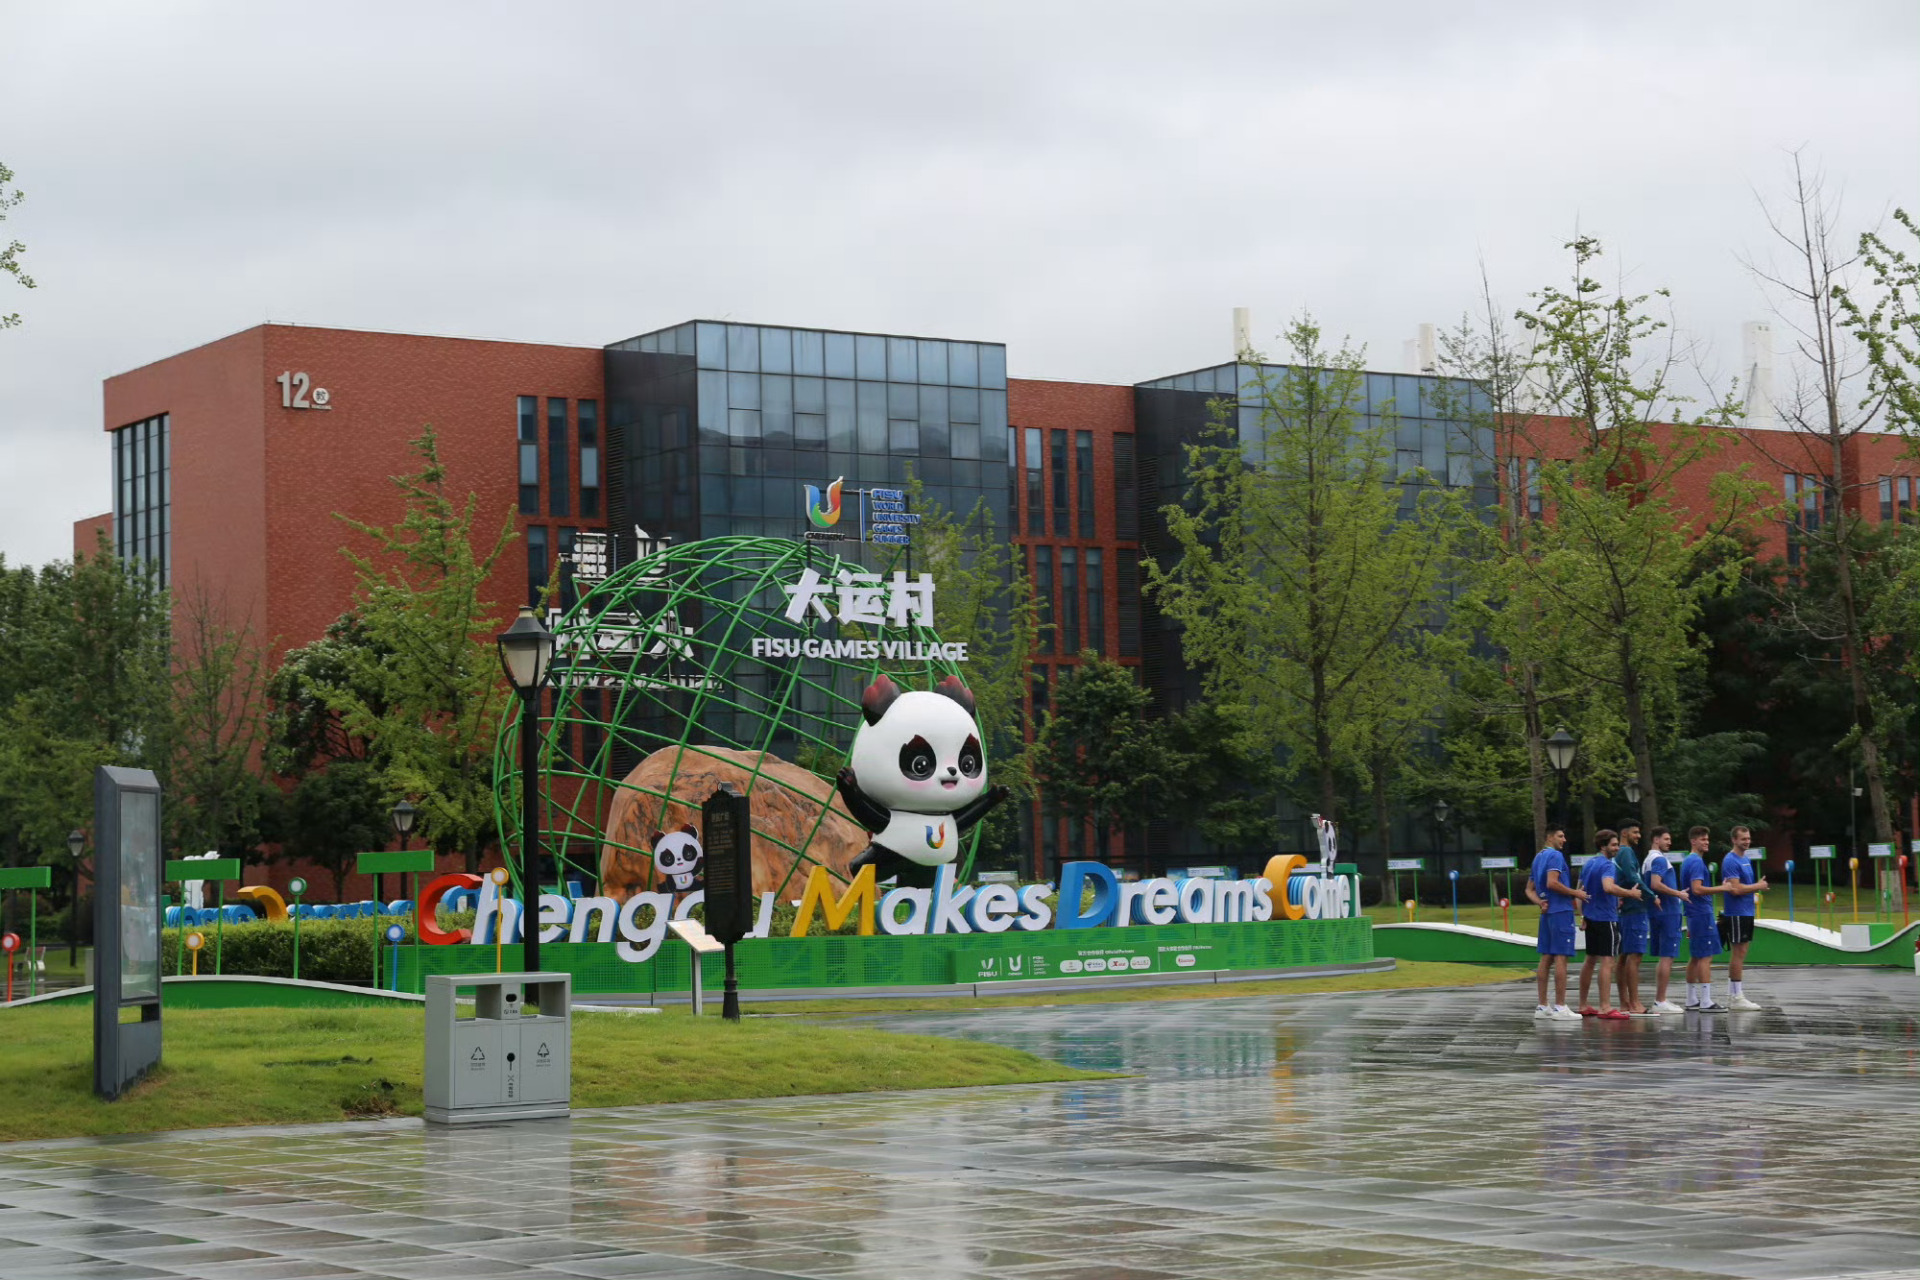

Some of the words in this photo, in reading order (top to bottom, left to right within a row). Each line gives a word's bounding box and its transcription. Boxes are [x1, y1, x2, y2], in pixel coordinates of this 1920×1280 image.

[277, 371, 310, 408] 12
[871, 489, 903, 500] FISU
[872, 500, 905, 512] WORLD
[872, 512, 921, 524] UNIVERSITY
[873, 523, 903, 534] GAMES
[873, 534, 910, 545] SUMMER
[784, 567, 936, 628] 大运村
[752, 637, 800, 658] FISU
[802, 638, 880, 659] GAMES
[881, 640, 969, 662] VILLAGE
[790, 863, 1053, 936] Makes
[1055, 861, 1273, 930] Dreams
